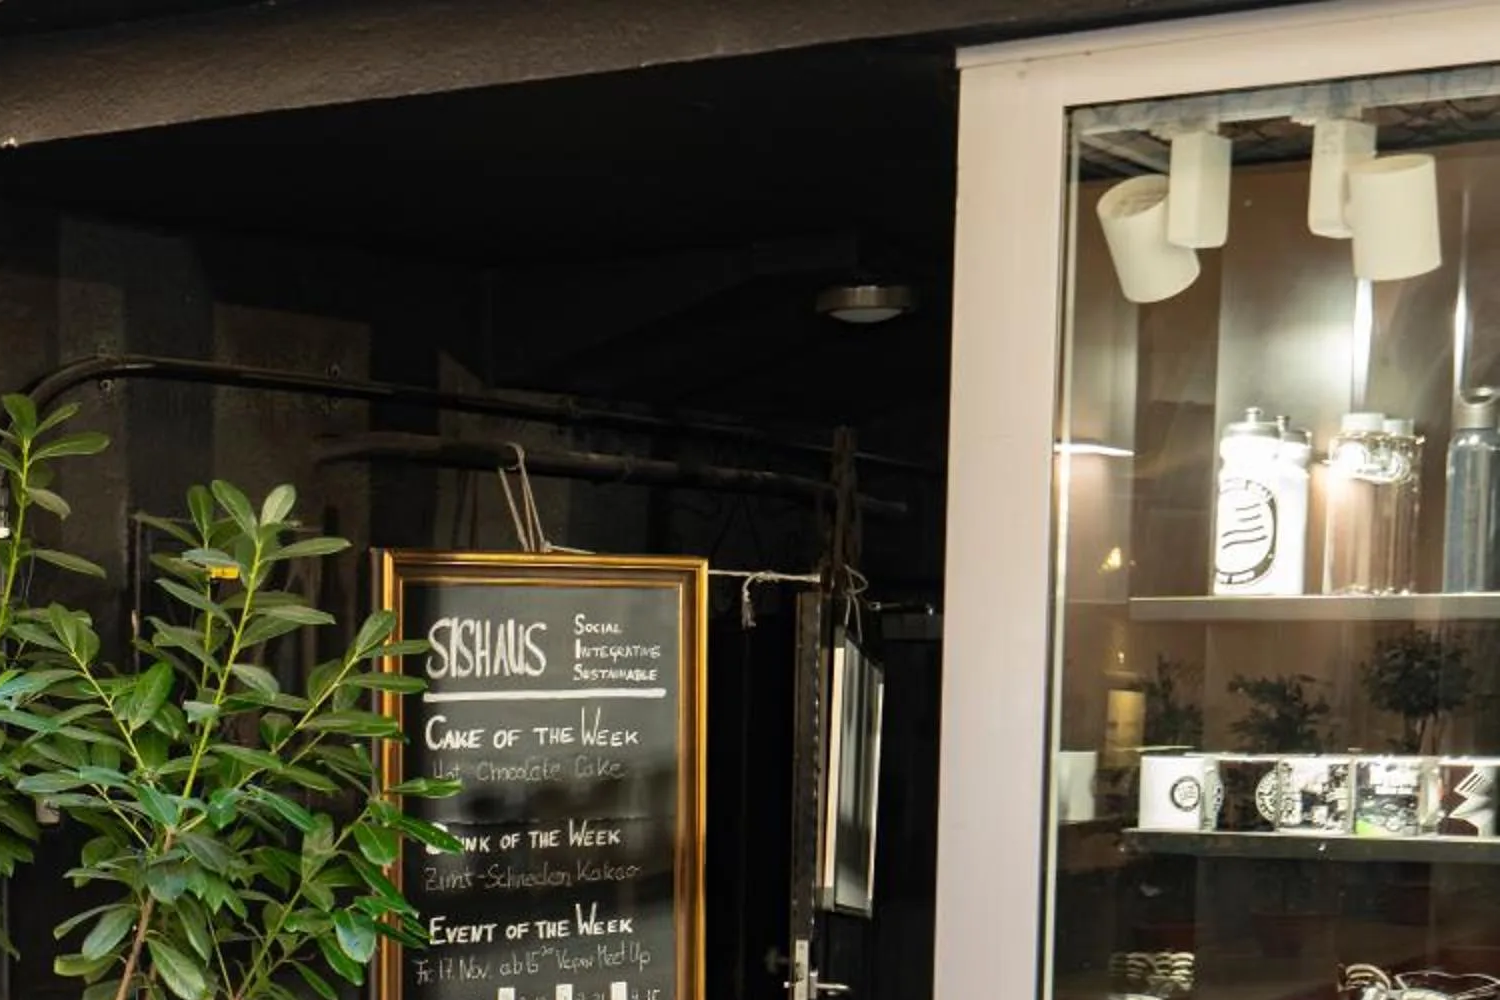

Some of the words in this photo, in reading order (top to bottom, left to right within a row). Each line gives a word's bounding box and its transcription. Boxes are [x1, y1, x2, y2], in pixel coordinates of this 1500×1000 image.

[426, 617, 548, 681] SISHAUS
[492, 728, 522, 750] OF
[533, 725, 577, 746] THE
[580, 705, 641, 747] WEEK
[499, 829, 521, 850] OF
[528, 828, 561, 849] THE
[568, 817, 622, 849] WEEK
[429, 915, 497, 947] EVENT
[505, 920, 529, 941] OF
[536, 918, 571, 939] THE
[574, 901, 635, 937] WEEK
